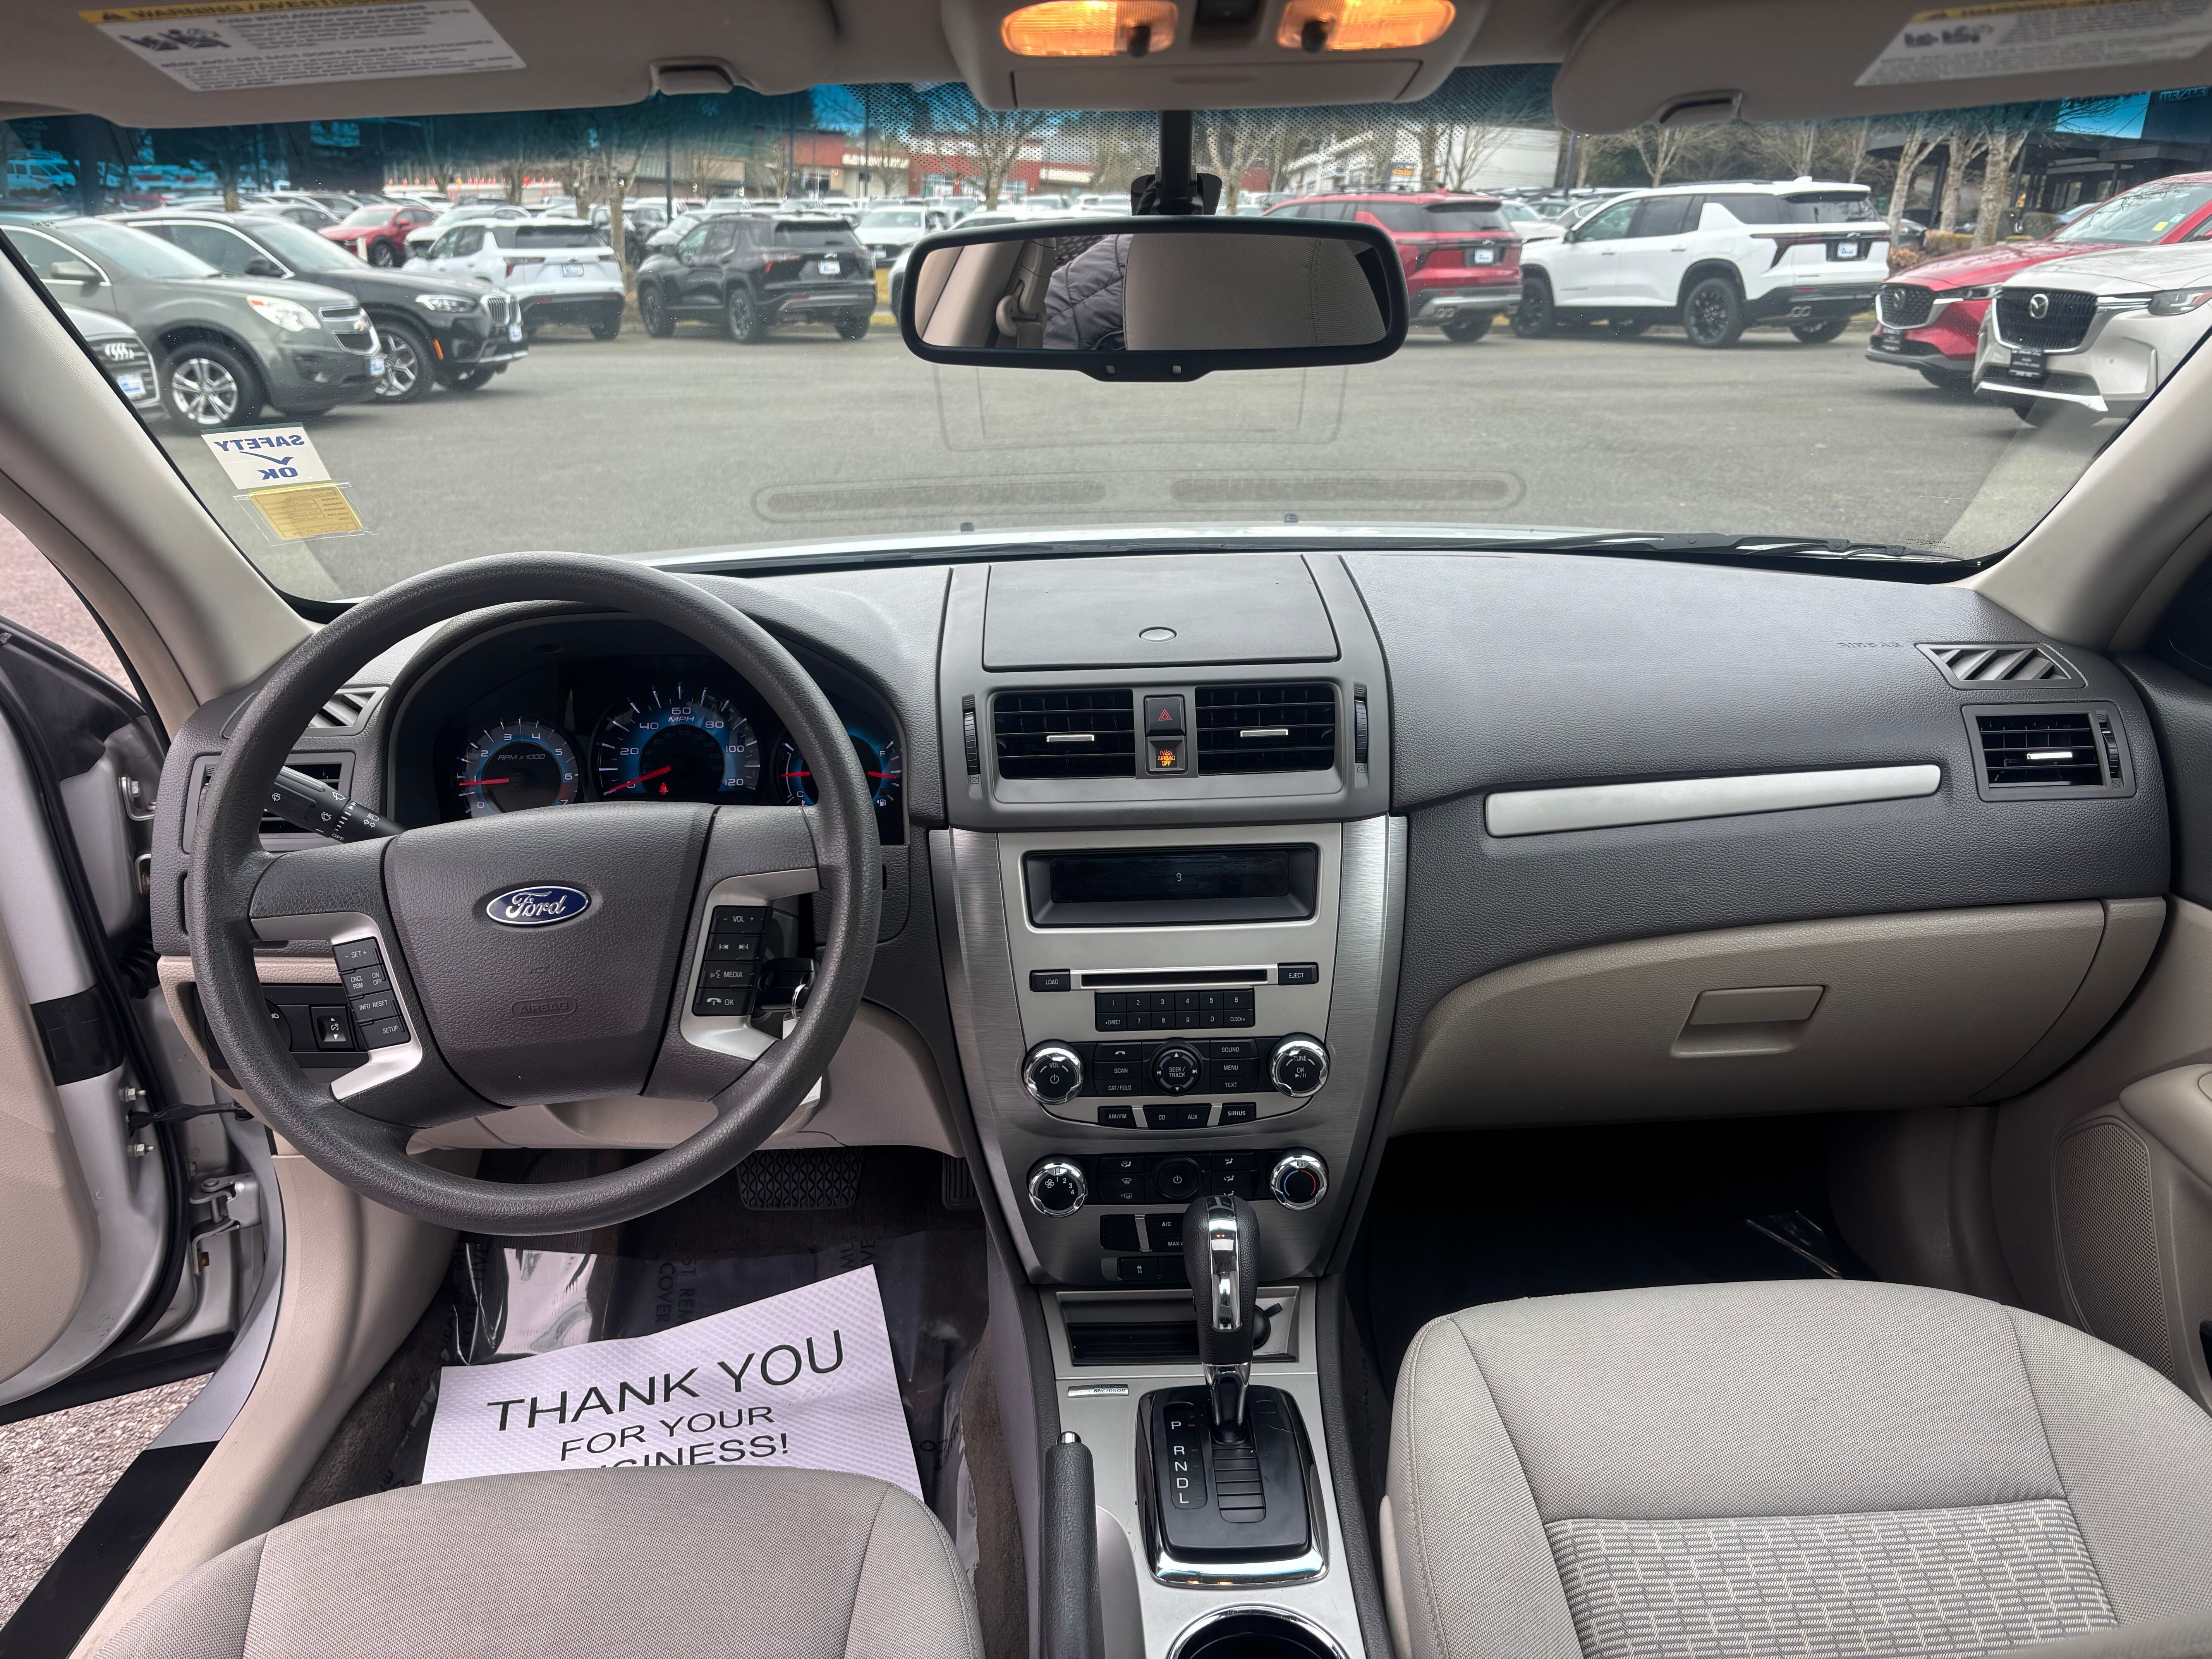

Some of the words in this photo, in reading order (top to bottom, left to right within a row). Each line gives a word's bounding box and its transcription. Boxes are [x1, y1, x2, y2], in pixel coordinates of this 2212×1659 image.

[672, 707, 692, 715] 60
[620, 747, 639, 756] 20
[725, 745, 744, 753] 100
[505, 891, 567, 918] Ford
[373, 1000, 388, 1008] RESET
[519, 1001, 568, 1014] AIRBAG
[382, 1025, 398, 1034] SETUP
[655, 1262, 676, 1323] COVER
[487, 1367, 701, 1431] THANK
[717, 1329, 845, 1393] YOU
[1171, 1421, 1182, 1429] P
[561, 1424, 646, 1462] FOR
[659, 1406, 775, 1438] YOUR
[601, 1433, 788, 1468] INESS!
[1173, 1446, 1185, 1455] R
[1175, 1461, 1187, 1472] N
[1176, 1478, 1188, 1488] D
[1179, 1492, 1189, 1504] L
